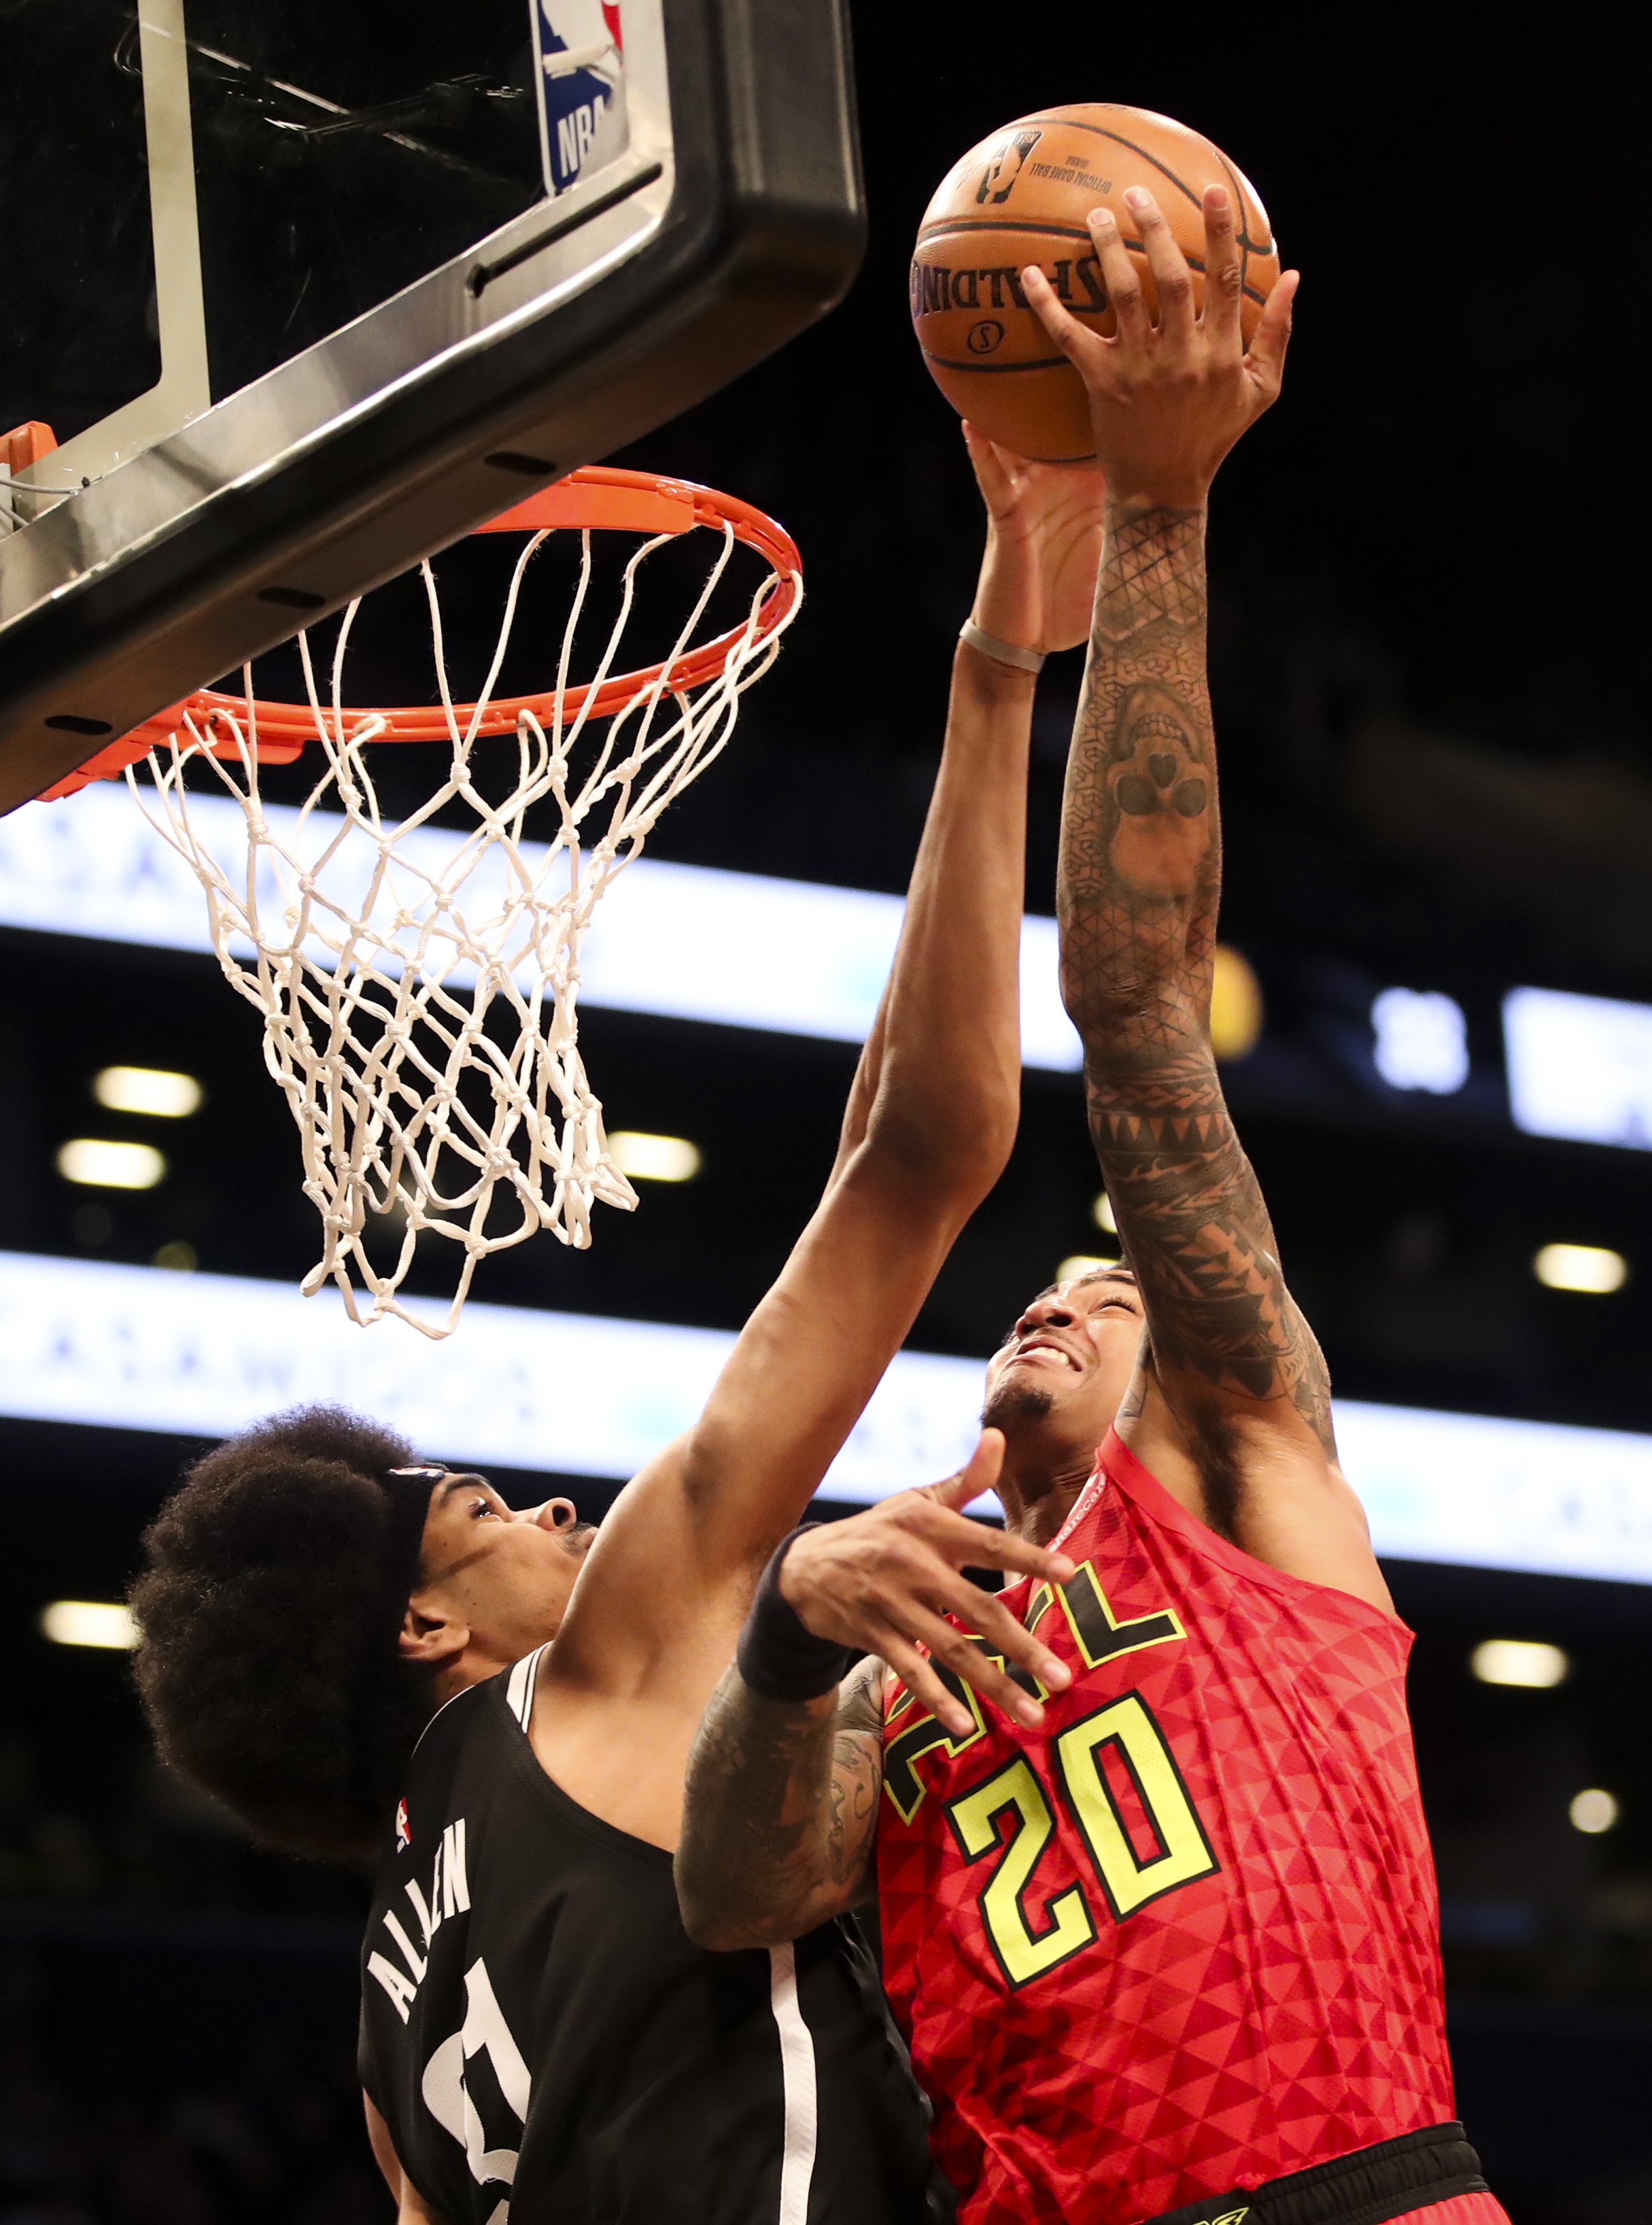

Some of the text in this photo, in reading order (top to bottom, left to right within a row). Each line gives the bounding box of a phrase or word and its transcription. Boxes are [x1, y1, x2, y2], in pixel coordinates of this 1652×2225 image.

[1031, 164, 1112, 194] OFFICIAL GAME BALL
[942, 1688, 1222, 1992] 20
